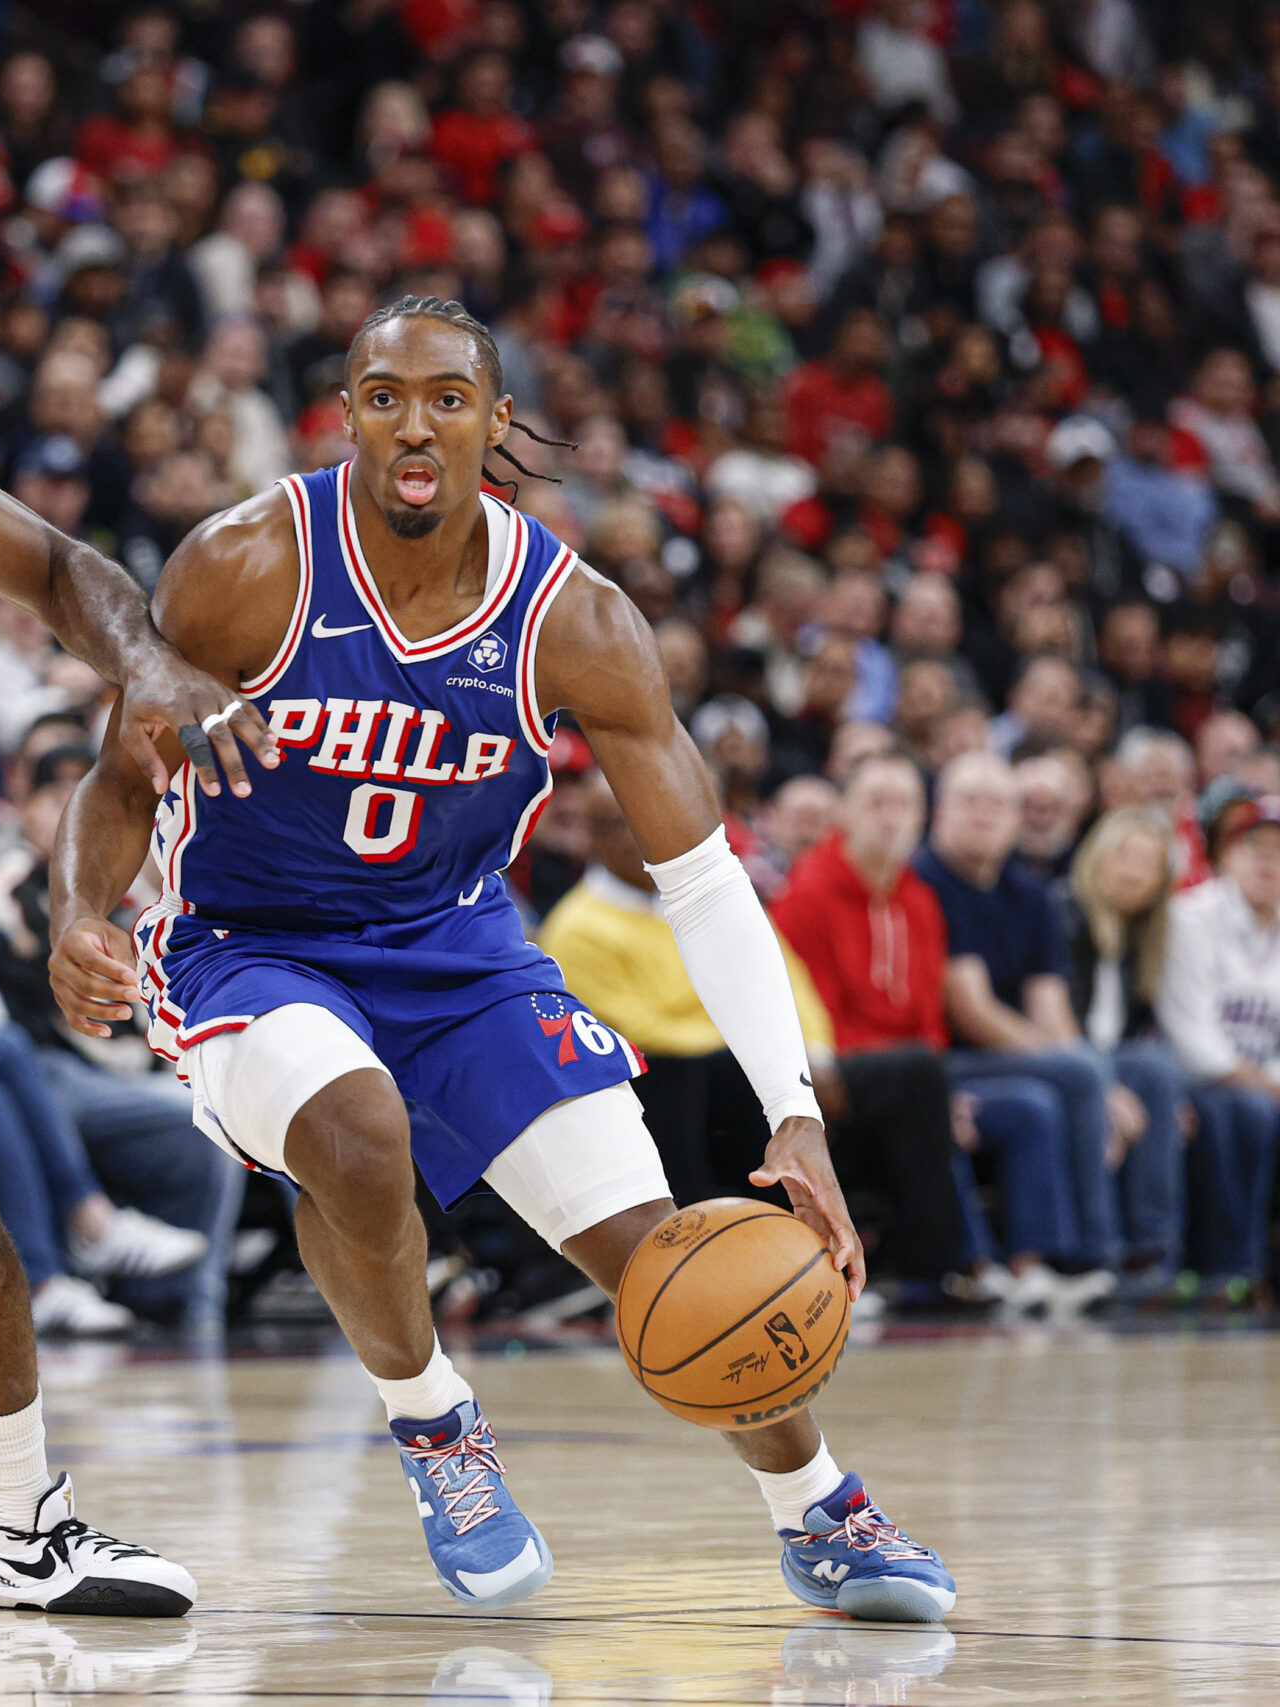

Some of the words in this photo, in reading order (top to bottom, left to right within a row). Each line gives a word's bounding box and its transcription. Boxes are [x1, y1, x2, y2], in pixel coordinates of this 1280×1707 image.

[446, 677, 514, 699] crypto.com
[268, 697, 517, 785] PHILA
[343, 782, 425, 863] 0
